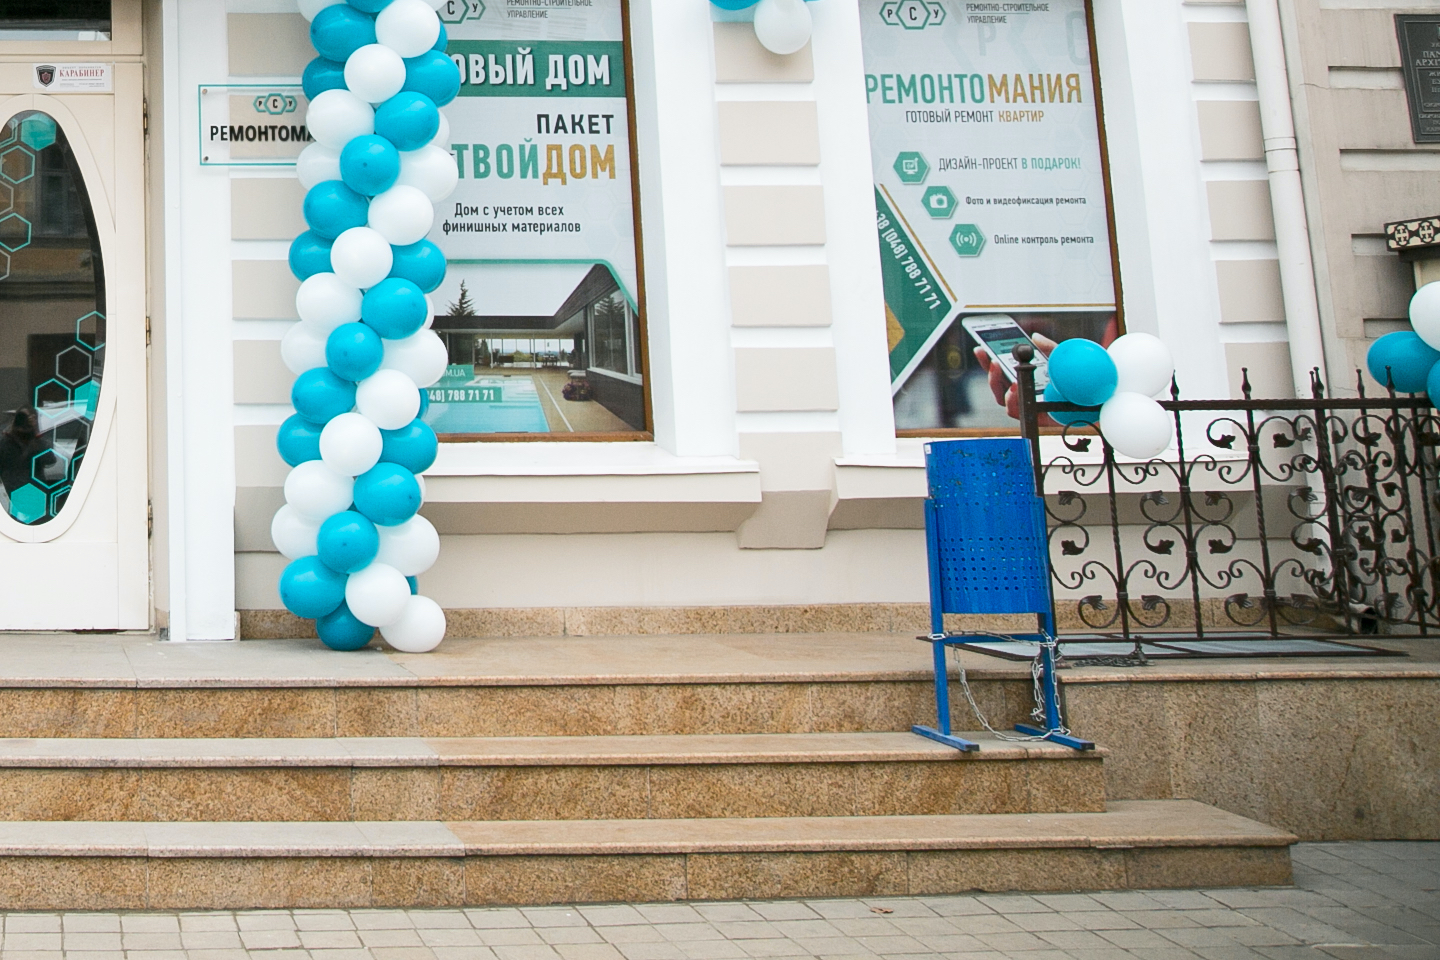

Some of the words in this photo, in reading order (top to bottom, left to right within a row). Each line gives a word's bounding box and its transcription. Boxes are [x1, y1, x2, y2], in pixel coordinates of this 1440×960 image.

[965, 2, 1050, 12] РЕМОНТНО-СТРОИТЕЛЬНОЕ
[506, 9, 549, 19] УПРАВЛЕНИЕ
[966, 15, 1008, 24] УПРАВЛЕНИЕ
[59, 69, 105, 78] КАРАБИНЕР
[545, 54, 611, 91] ДОМ
[905, 108, 952, 123] ГОТОВЫЙ
[954, 110, 994, 123] РЕМОНТ
[998, 110, 1045, 123] КВАРТИР
[536, 113, 615, 135] ПАКЕТ
[938, 156, 1019, 172] ДИЗАЙН-ПРОЕКТ
[1021, 157, 1028, 170] В
[1031, 157, 1082, 171] ПОДАРОК!
[965, 196, 984, 205] Фото
[993, 196, 1054, 207] видеофиксация
[1055, 197, 1087, 207] ремонта
[454, 202, 479, 218] Дом
[482, 206, 490, 216] с
[493, 206, 534, 220] учетом
[538, 206, 565, 216] всех
[442, 219, 508, 236] финишных
[511, 222, 582, 236] материалов
[994, 235, 1019, 245] Online
[1021, 235, 1059, 246] контроль
[1061, 236, 1094, 246] ремонта
[900, 255, 922, 279] 788
[914, 277, 932, 294] 71
[924, 292, 941, 310] 71
[447, 389, 466, 401] 788
[468, 389, 480, 401] 71
[482, 389, 495, 401] 71
